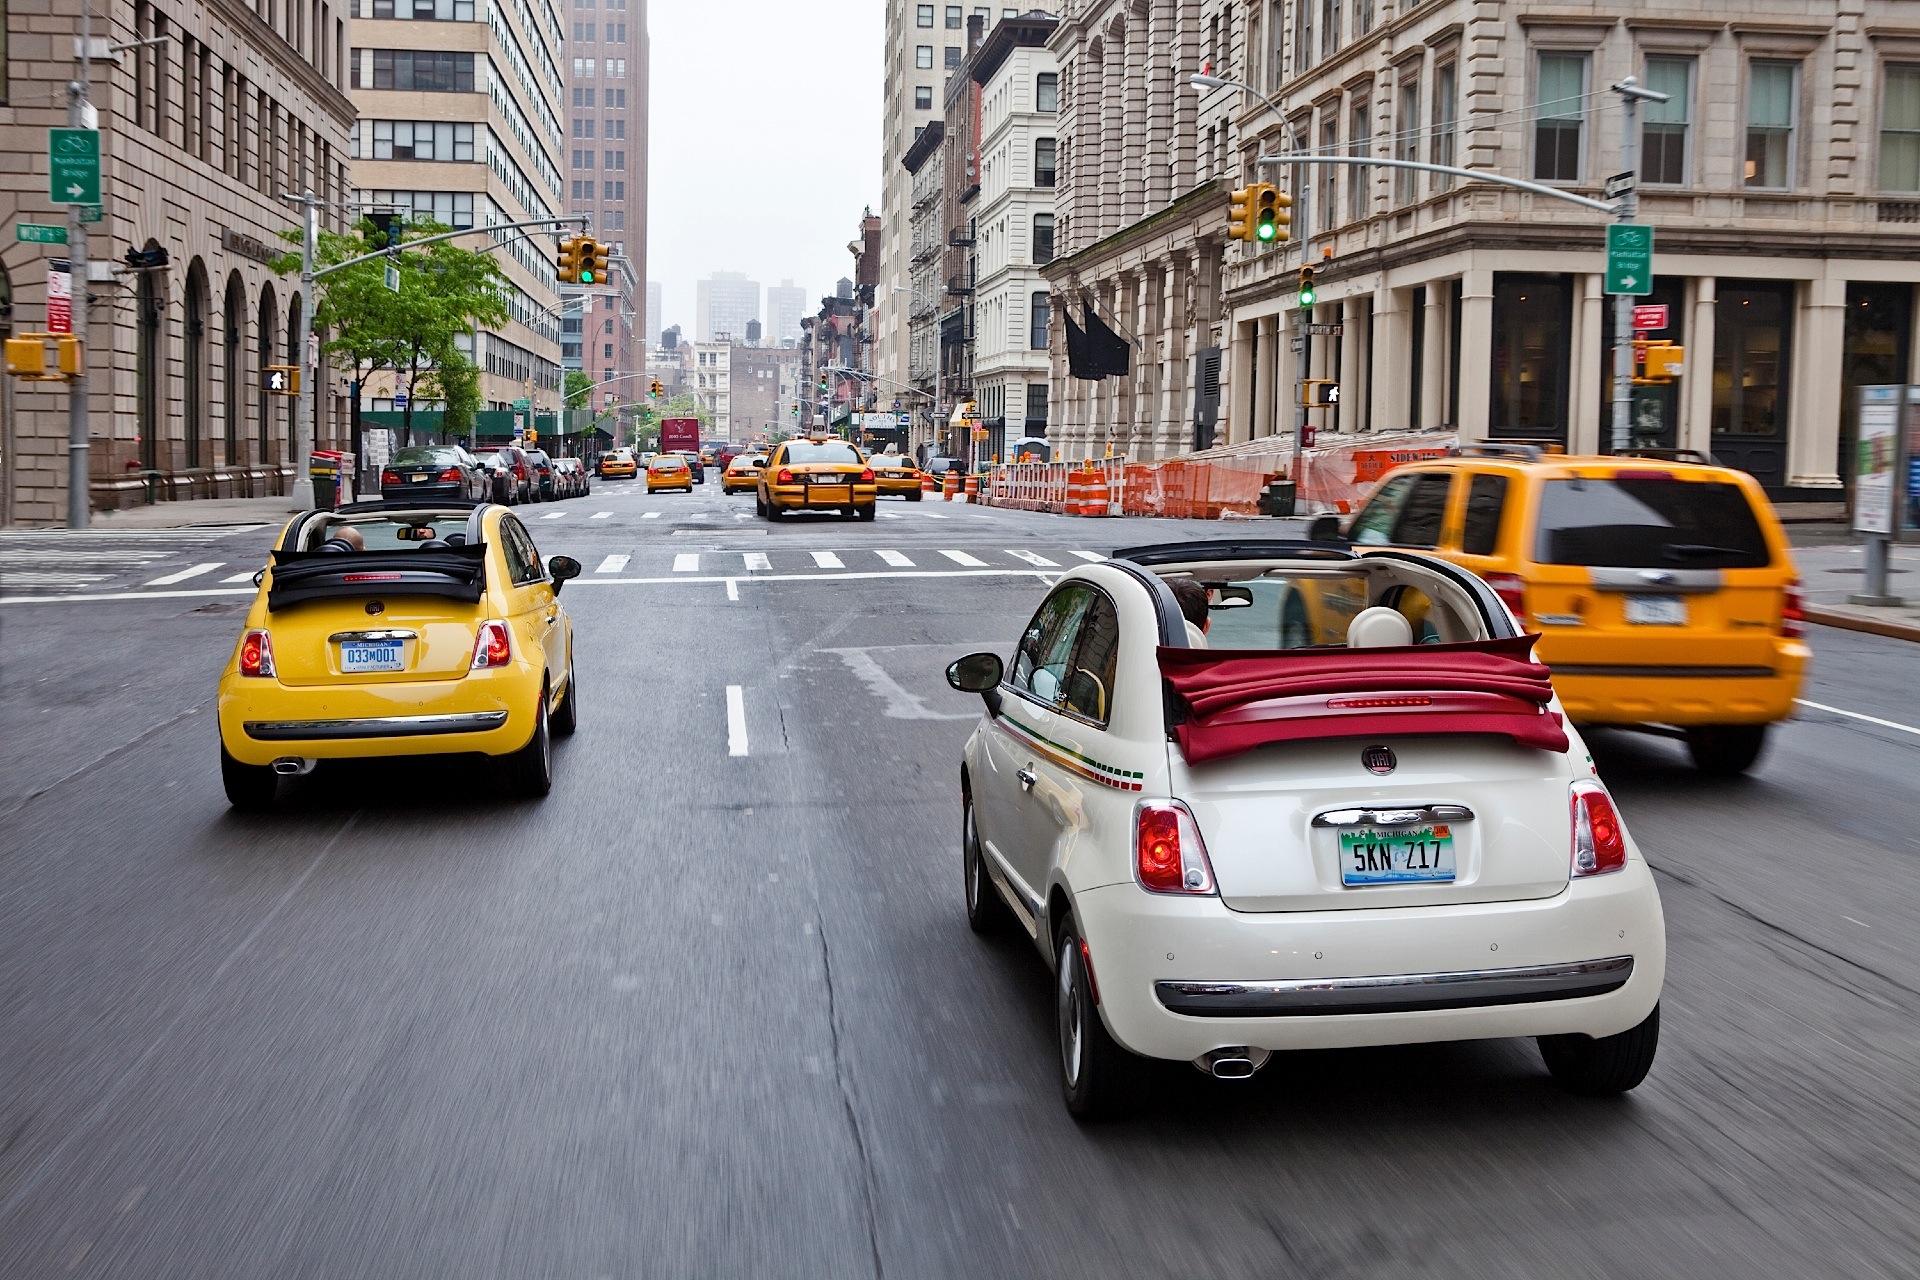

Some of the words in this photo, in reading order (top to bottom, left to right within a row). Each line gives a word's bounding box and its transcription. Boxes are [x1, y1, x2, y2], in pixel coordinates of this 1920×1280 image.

[1333, 325, 1342, 335] ST
[348, 649, 396, 663] 033M001
[1371, 753, 1390, 766] FIAT
[1376, 830, 1419, 838] MICHIGAN
[1353, 843, 1392, 872] 5KN
